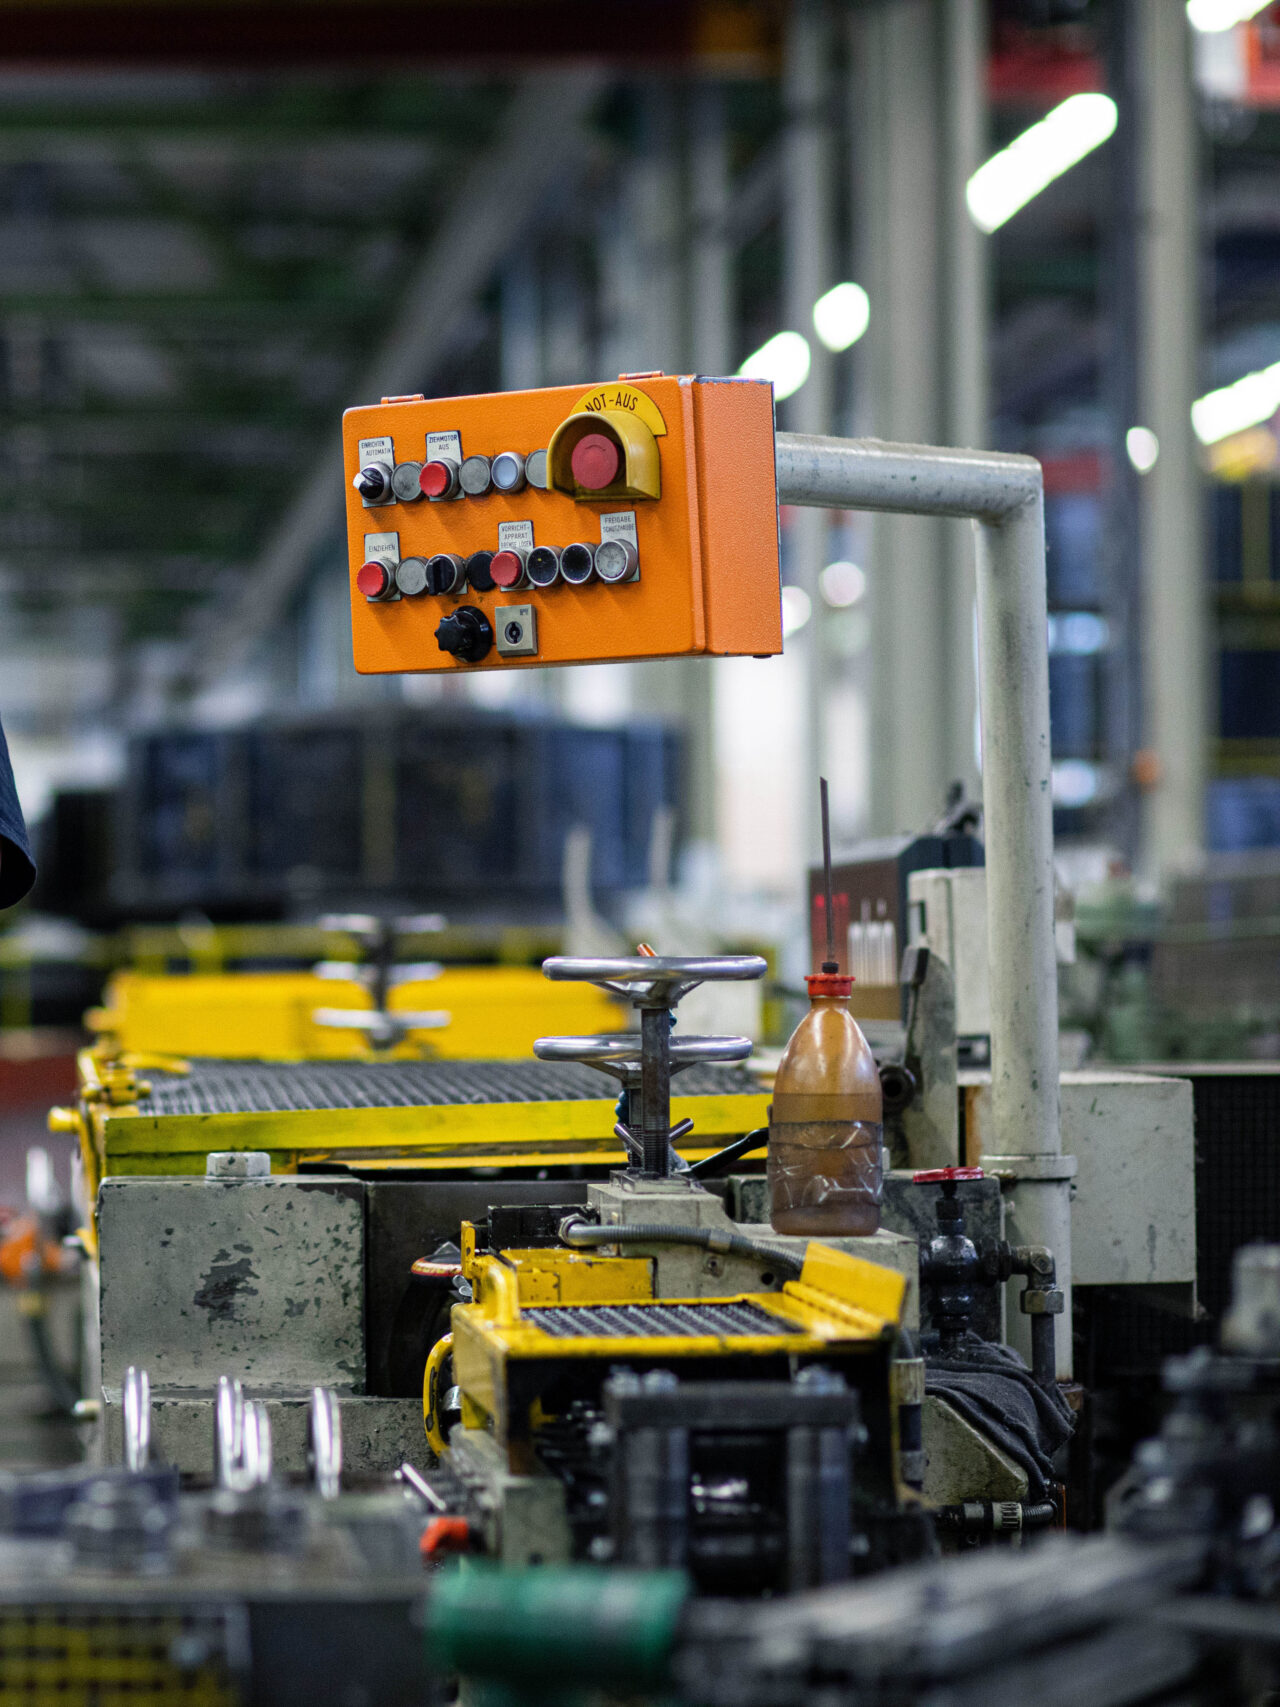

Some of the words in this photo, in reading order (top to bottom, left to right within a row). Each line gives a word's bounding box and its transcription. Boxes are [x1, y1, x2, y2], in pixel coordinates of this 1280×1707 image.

[585, 391, 638, 412] NOT-AUS
[428, 435, 458, 444] ZIEHMOTOR
[361, 440, 385, 449] EINRICHTEN
[368, 544, 395, 553] EINZIEHEN
